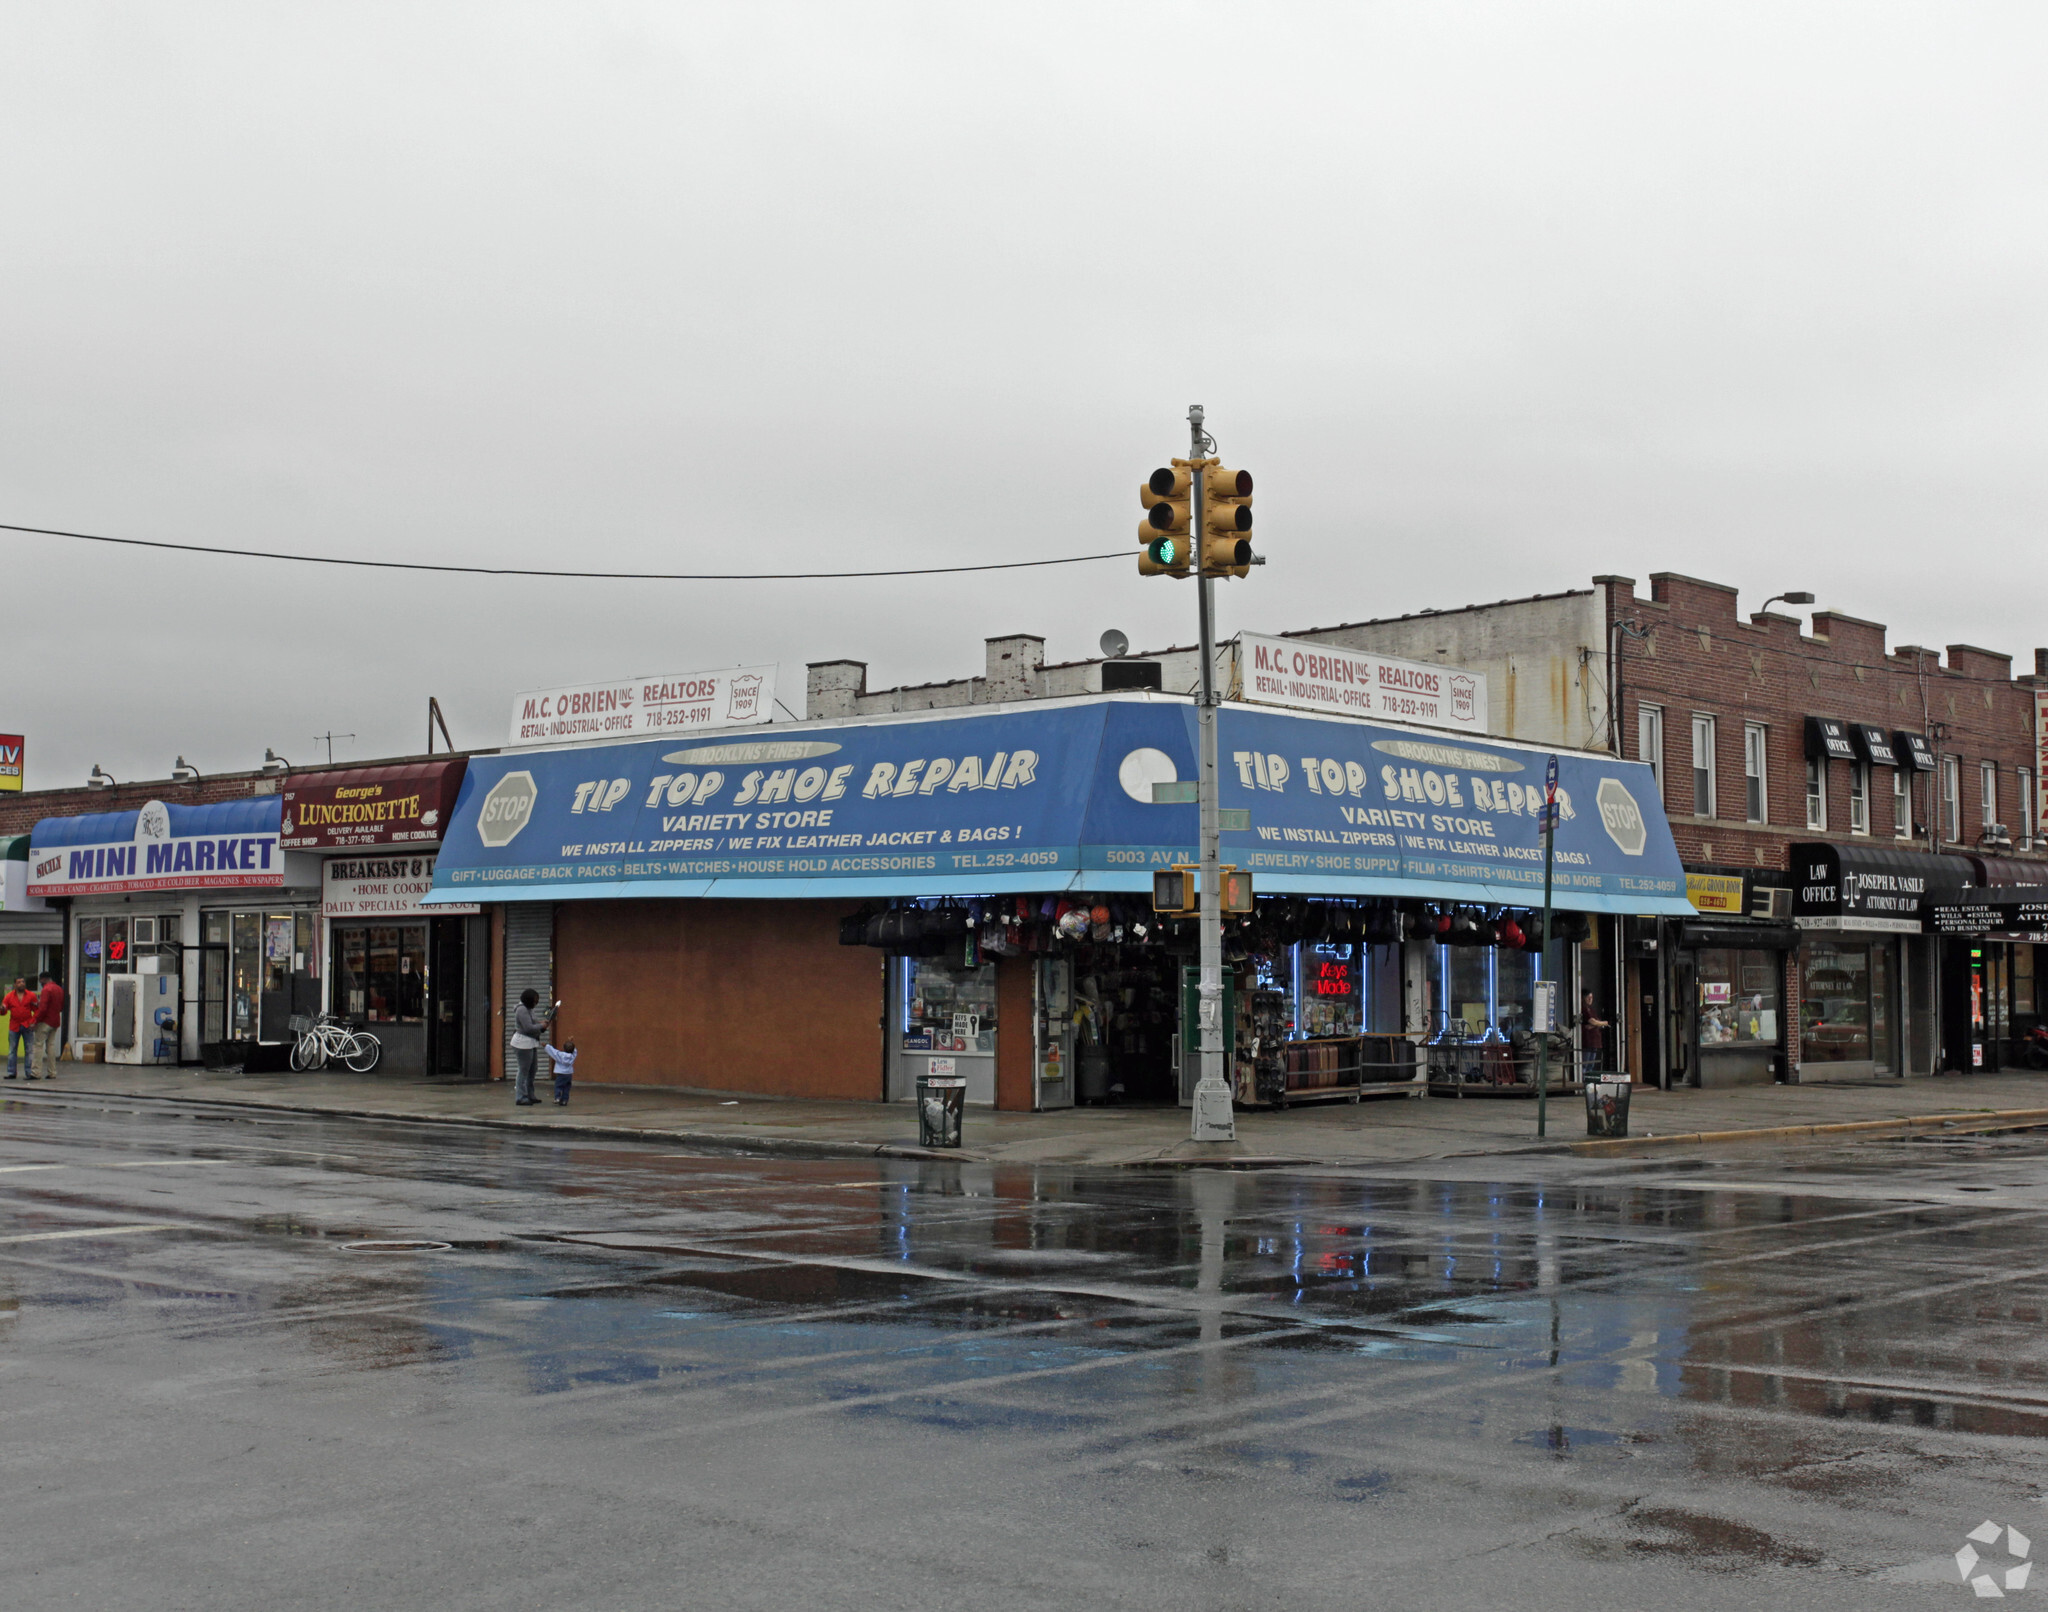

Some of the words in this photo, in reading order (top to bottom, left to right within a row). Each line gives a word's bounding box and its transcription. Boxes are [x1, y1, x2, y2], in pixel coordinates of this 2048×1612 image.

[1255, 645, 1287, 674] M.C.
[1293, 652, 1353, 684] O'BRIEN
[1355, 662, 1370, 677] INC.
[1378, 665, 1439, 692] REALTORS
[643, 679, 715, 701] REALTORS
[733, 687, 757, 698] SINCE
[1255, 676, 1285, 695] RETAIL
[1289, 681, 1339, 703] INDUSTRIAL
[1343, 690, 1371, 708] OFFICE
[1453, 687, 1472, 699] SINCE
[522, 697, 551, 719] M.C.
[557, 689, 617, 716] O'BRIEN
[619, 687, 634, 701] INC.
[735, 700, 752, 709] 1909
[1382, 695, 1438, 718] 718-252-9191
[1455, 699, 1470, 710] 1909
[646, 707, 711, 727] 718-252-9191
[520, 723, 545, 738] RETAIL
[550, 718, 600, 735] INDUSTRIAL
[604, 715, 633, 731] OFFICE
[1824, 723, 1839, 736] LAW
[1827, 739, 1851, 752] OFFICE
[1868, 731, 1882, 743] LAW
[1911, 738, 1925, 750] LAW
[767, 743, 812, 760] FINEST
[1870, 745, 1893, 758] OFFICE
[1914, 752, 1935, 765] OFFICE
[1466, 754, 1501, 770] FINEST
[570, 777, 631, 814] TIP
[645, 771, 724, 808] TOP
[733, 764, 854, 806] SHOE
[862, 750, 1039, 799] REPAIR
[1233, 751, 1290, 793] TIP
[1301, 757, 1366, 798] TOP
[1381, 764, 1464, 808] SHOE
[335, 784, 383, 800] George's
[299, 794, 420, 826] LUNCHONETTE
[486, 796, 529, 822] STOP
[1603, 802, 1637, 829] STOP
[662, 813, 752, 832] VARIETY
[755, 810, 834, 829] STORE
[1340, 806, 1425, 830] VARIETY
[1431, 816, 1495, 837] STORE
[327, 827, 353, 835] DELIVERY
[354, 825, 384, 833] AVAILABLE
[392, 832, 409, 840] HOME
[410, 830, 438, 840] COOKING
[280, 838, 301, 847] COFFEE
[301, 837, 318, 845] SHOP
[335, 835, 375, 845] 718-377-9182
[561, 845, 583, 857] WE
[585, 842, 645, 855] INSTALL
[648, 838, 714, 852] ZIPPERS
[729, 837, 754, 849] WE
[756, 836, 783, 849] FIX
[786, 834, 862, 848] LEATHER
[866, 830, 937, 846] JACKET
[940, 830, 952, 843] &
[1257, 826, 1281, 841] WE
[1282, 827, 1340, 844] INSTALL
[1340, 831, 1396, 847] ZIPPERS
[1405, 835, 1426, 849] WE
[1426, 837, 1447, 851] FIX
[1448, 840, 1500, 857] LEATHER
[1502, 846, 1544, 861] JACKET
[69, 846, 137, 879] MINI
[146, 838, 276, 874] MARKET
[1106, 851, 1145, 863] 5003
[1150, 851, 1177, 863] AV
[36, 855, 62, 878] SICILY
[330, 859, 408, 881] BREAKFAST
[411, 859, 423, 878] &
[451, 870, 477, 882] GIFT
[482, 868, 535, 881] LUGGAGE
[541, 866, 573, 879] BACK
[577, 864, 616, 877] PACKS
[624, 862, 661, 875] BELTS
[668, 861, 730, 874] WATCHES
[738, 860, 784, 873] HOUSE
[788, 859, 827, 872] HOLD
[831, 856, 936, 871] ACCESSORIES
[951, 851, 1058, 868] TEL.252-4059
[1247, 853, 1309, 868] JEWELRY
[1315, 855, 1351, 869] SHOE
[1354, 857, 1400, 872] SUPPLY
[1408, 861, 1435, 874] FILM
[1442, 864, 1491, 879] T-SHIRTS
[1495, 868, 1544, 884] WALLETS
[1573, 875, 1602, 887] MORE
[1619, 878, 1676, 892] TEL.252-4059
[1810, 864, 1828, 880] LAW
[29, 886, 43, 894] SODA
[46, 885, 66, 893] JUICES
[67, 884, 88, 893] CANDY
[90, 882, 124, 892] CIGARETTES
[127, 880, 154, 890] TOBACCO
[157, 879, 166, 888] ICE
[167, 878, 184, 887] COLD
[185, 877, 199, 886] BEER
[203, 876, 239, 886] MAGAZINES
[243, 875, 284, 885] NEWSPAPERS
[358, 884, 388, 895] HOME
[1858, 873, 1888, 890] JOSEPH
[1889, 875, 1897, 891] R.
[1898, 877, 1925, 893] VASILE
[1802, 886, 1837, 902] OFFICE
[325, 901, 355, 913] DAILY
[358, 900, 407, 912] SPECIALS
[1866, 895, 1897, 910] ATTORNEY
[1897, 898, 1906, 911] AT
[1906, 898, 1919, 912] LAW
[1320, 962, 1348, 979] Keys
[1317, 979, 1351, 994] Made
[954, 1014, 967, 1022] KEYS
[954, 1028, 967, 1036] HERE
[936, 1064, 953, 1072] Fidler
